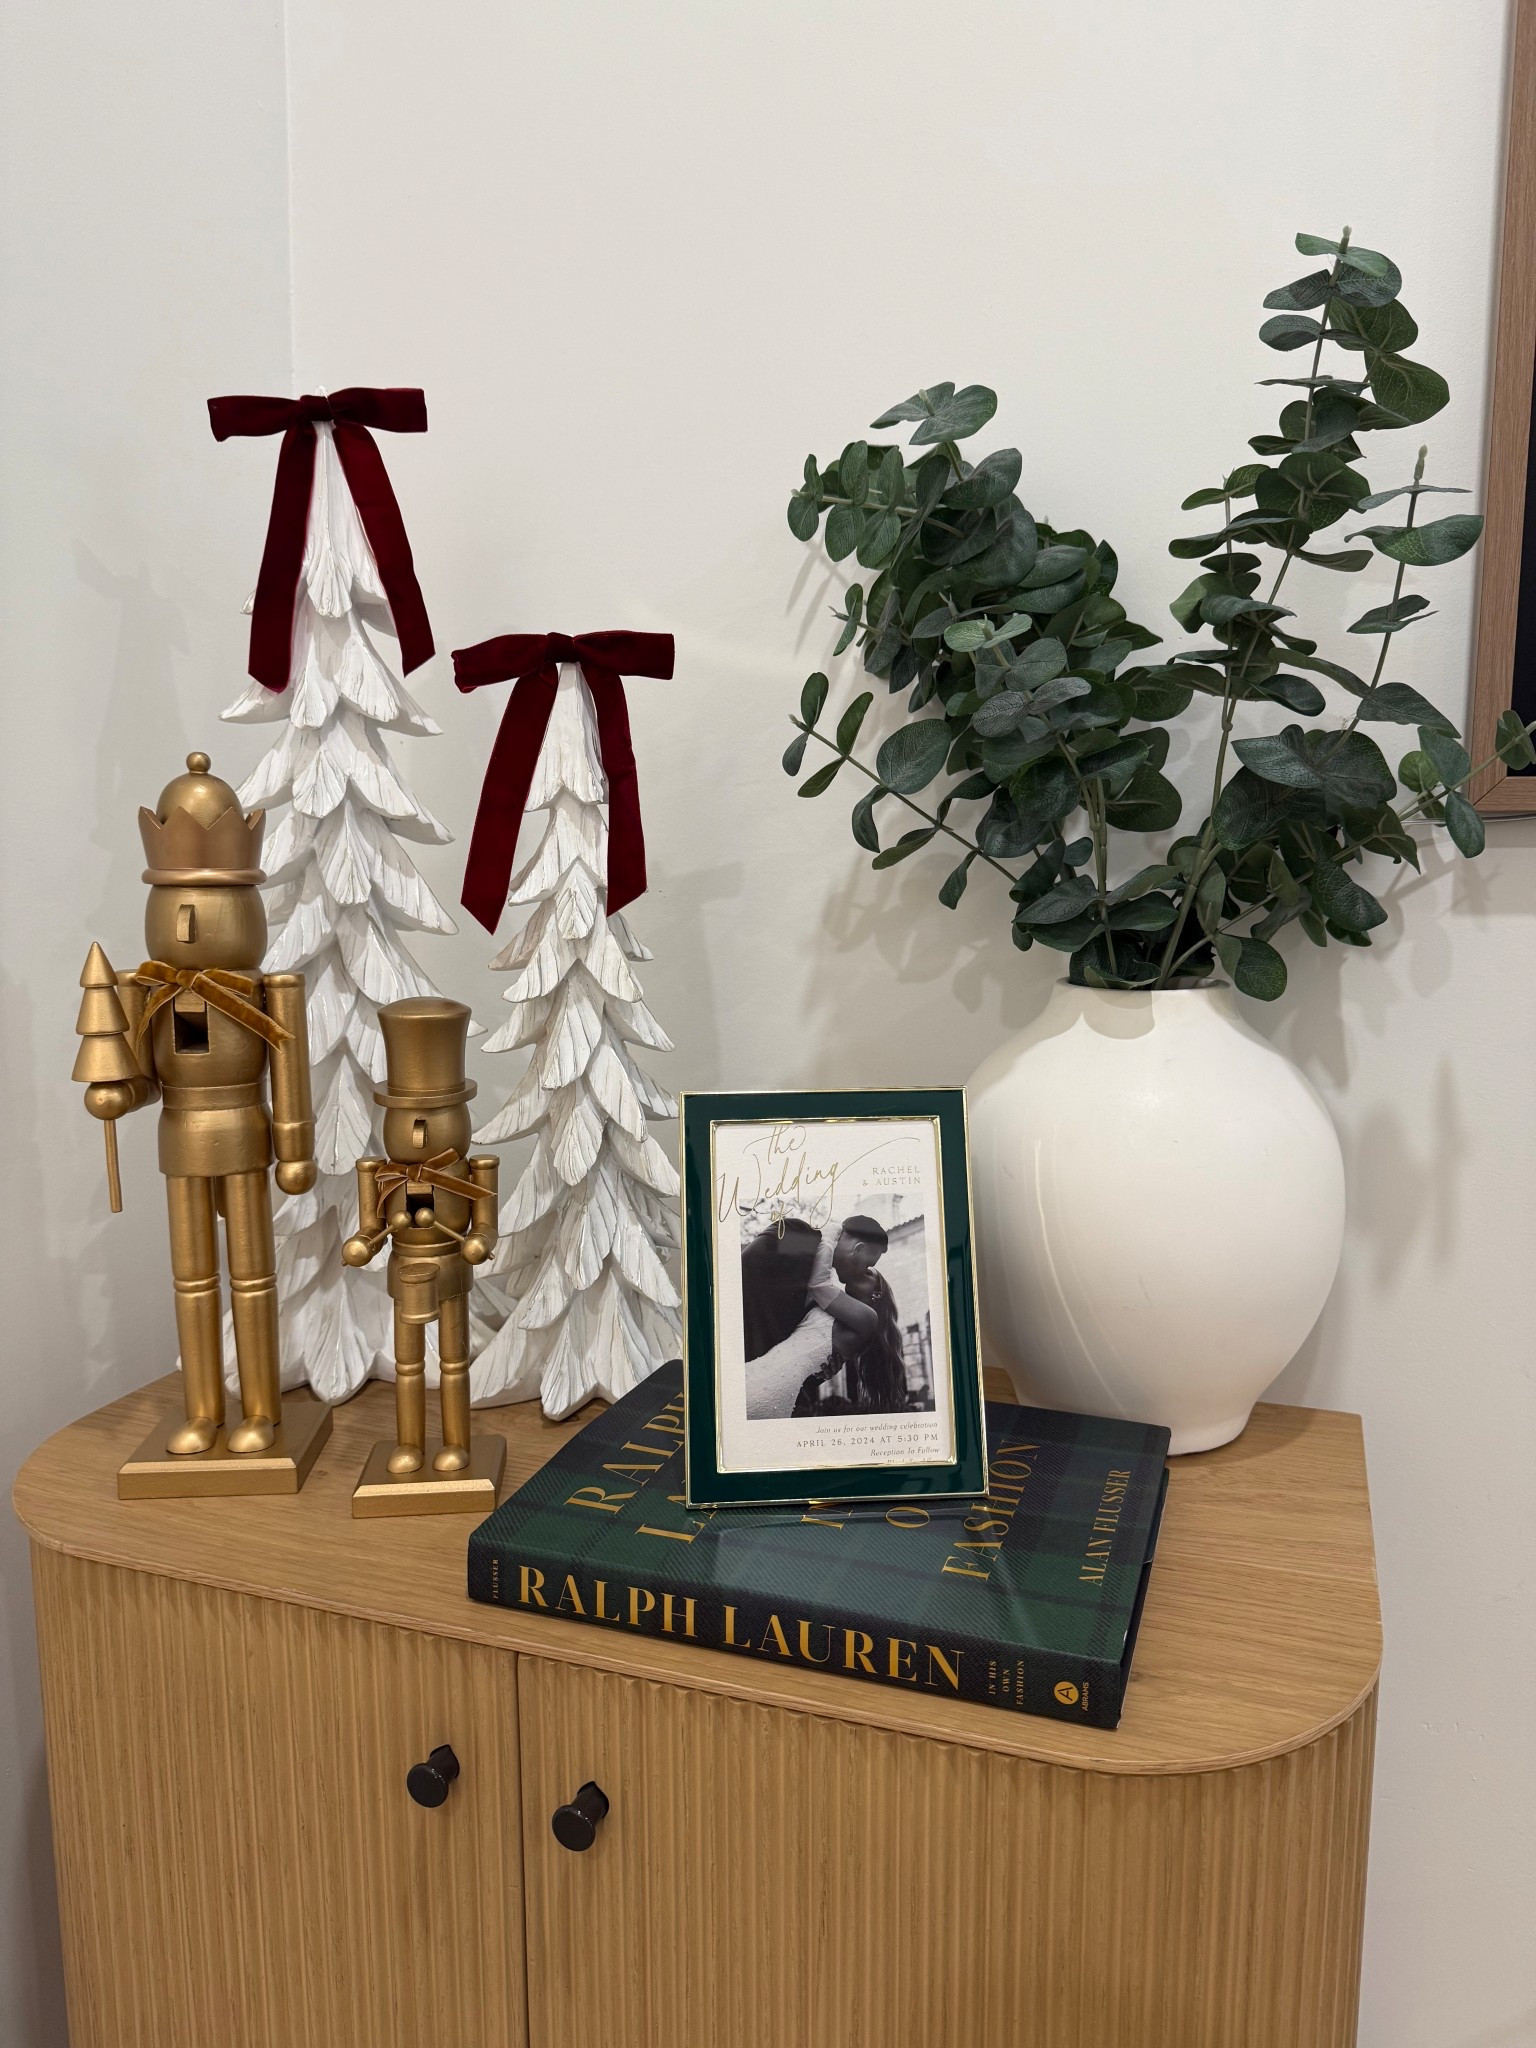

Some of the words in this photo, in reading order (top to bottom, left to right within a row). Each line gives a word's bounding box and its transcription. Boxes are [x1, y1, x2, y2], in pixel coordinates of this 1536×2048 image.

[862, 1178, 869, 1187] &
[875, 1176, 921, 1186] AUSTIN
[872, 1164, 921, 1175] RACHEL
[769, 1200, 794, 1240] of
[815, 1426, 831, 1434] Join
[843, 1424, 853, 1434] for
[869, 1422, 898, 1431] wedding
[900, 1420, 938, 1430] celebration
[796, 1439, 825, 1448] APRIL
[850, 1437, 875, 1445] 2024
[880, 1435, 892, 1443] AT
[897, 1434, 919, 1443] 5:30
[924, 1433, 938, 1441] PM
[870, 1448, 905, 1457] Reception
[907, 1447, 915, 1455] To
[917, 1445, 940, 1454] Follow
[941, 1438, 1041, 1581] FASHION
[1092, 1470, 1131, 1533] FLUSSER
[1079, 1536, 1112, 1587] ALAN
[518, 1564, 698, 1638] RALPH
[722, 1604, 965, 1691] LAUREN
[988, 1660, 997, 1679] HIS
[1002, 1668, 1010, 1693] OWN
[988, 1683, 997, 1695] IN
[1016, 1660, 1025, 1705] FASHION
[1081, 1682, 1090, 1712] ABRAMS
